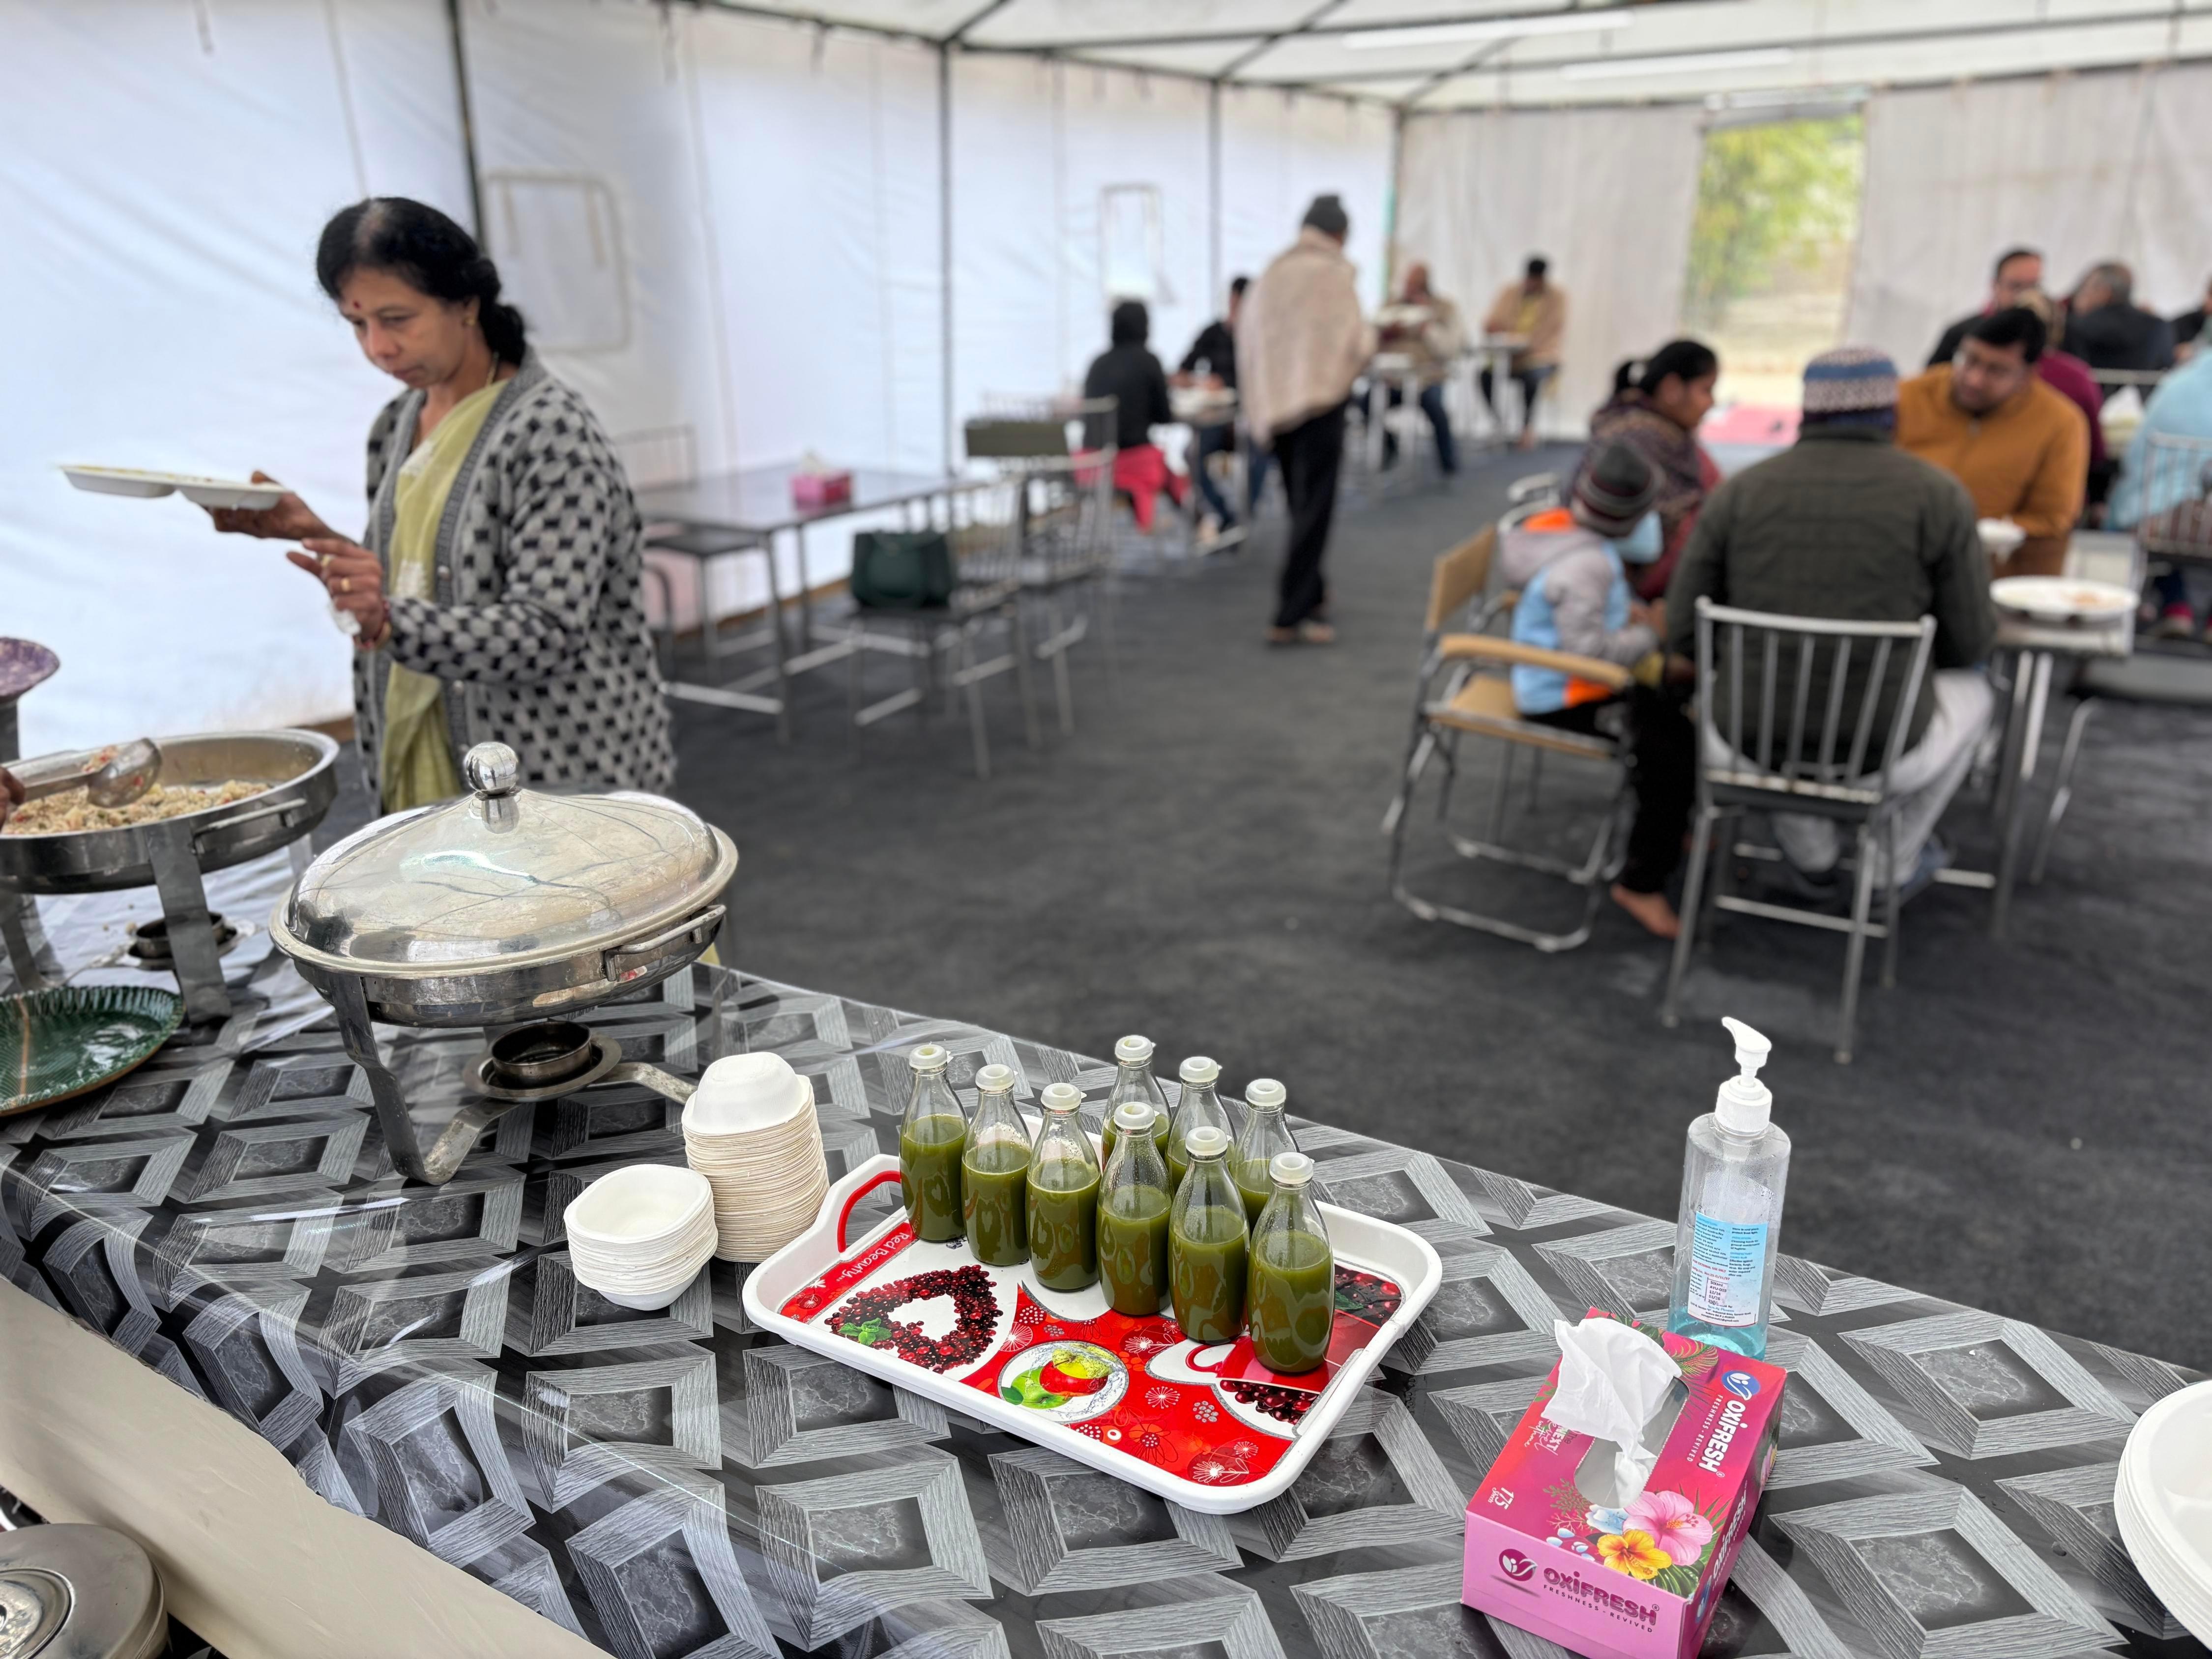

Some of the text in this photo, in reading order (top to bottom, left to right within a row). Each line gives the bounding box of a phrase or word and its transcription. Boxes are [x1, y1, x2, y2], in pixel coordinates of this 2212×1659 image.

[883, 1232, 910, 1250] Red
[1702, 1394, 1723, 1429] FRESHNESS
[1687, 1433, 1705, 1462] REVIVED
[1494, 1487, 1514, 1510] 175
[1543, 1584, 1599, 1611] FRESHNESS
[1610, 1611, 1653, 1633] REVIVED
